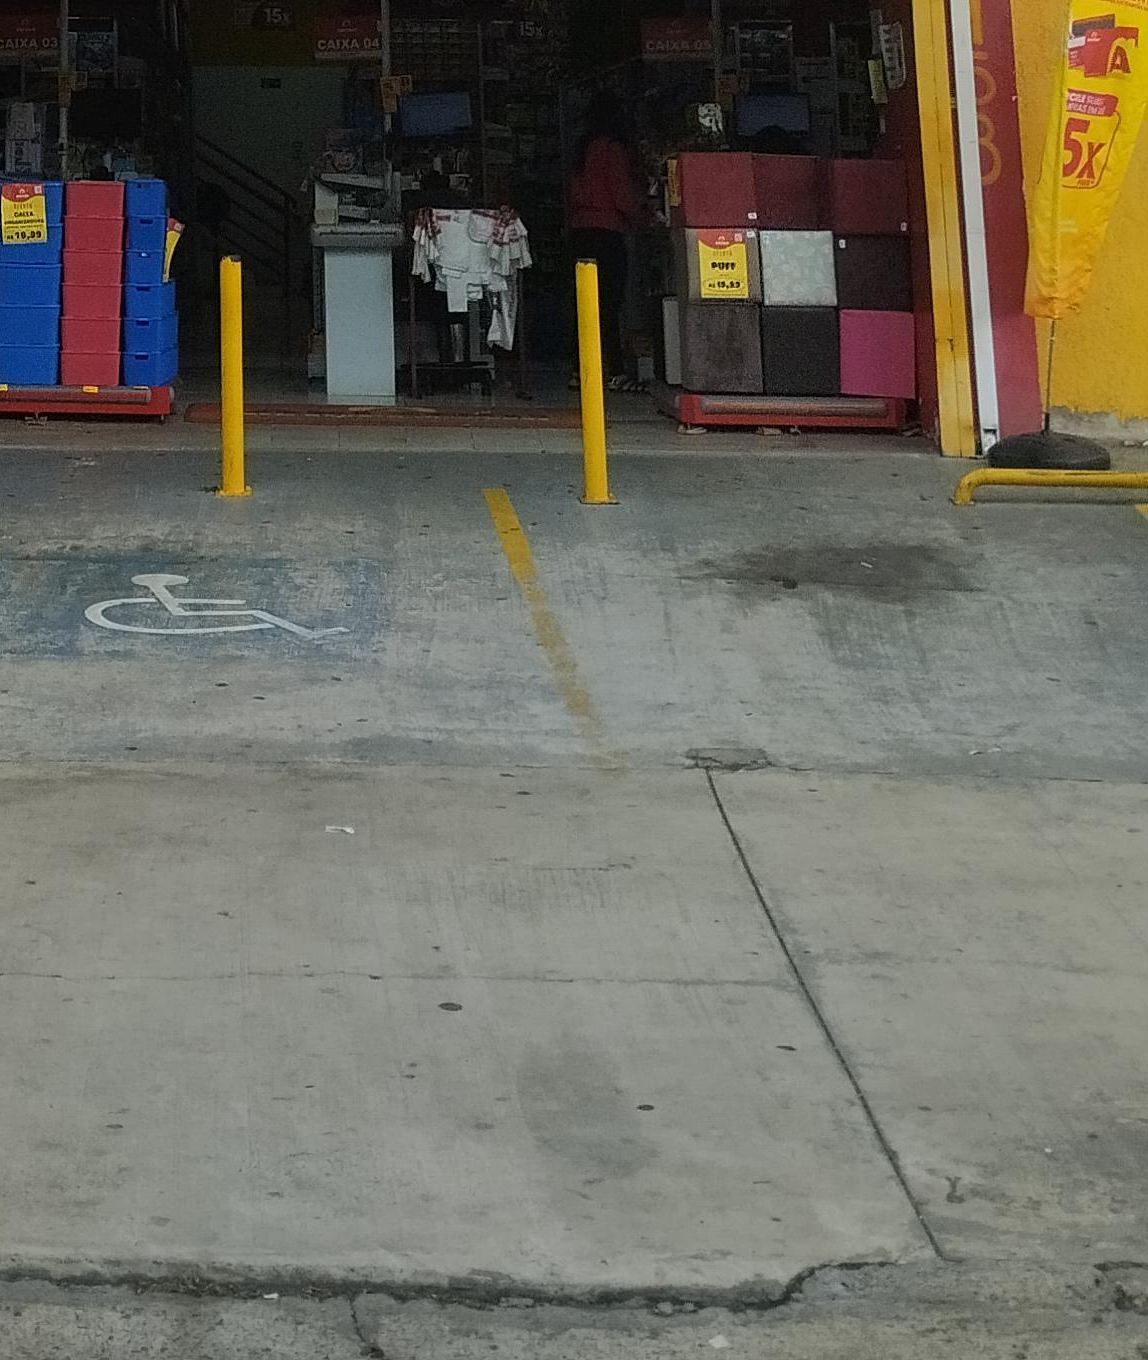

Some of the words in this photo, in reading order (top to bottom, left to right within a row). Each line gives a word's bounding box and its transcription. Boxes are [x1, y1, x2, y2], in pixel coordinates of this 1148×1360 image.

[41, 36, 59, 49] 03
[316, 38, 360, 51] CAIXA
[363, 37, 381, 50] 04
